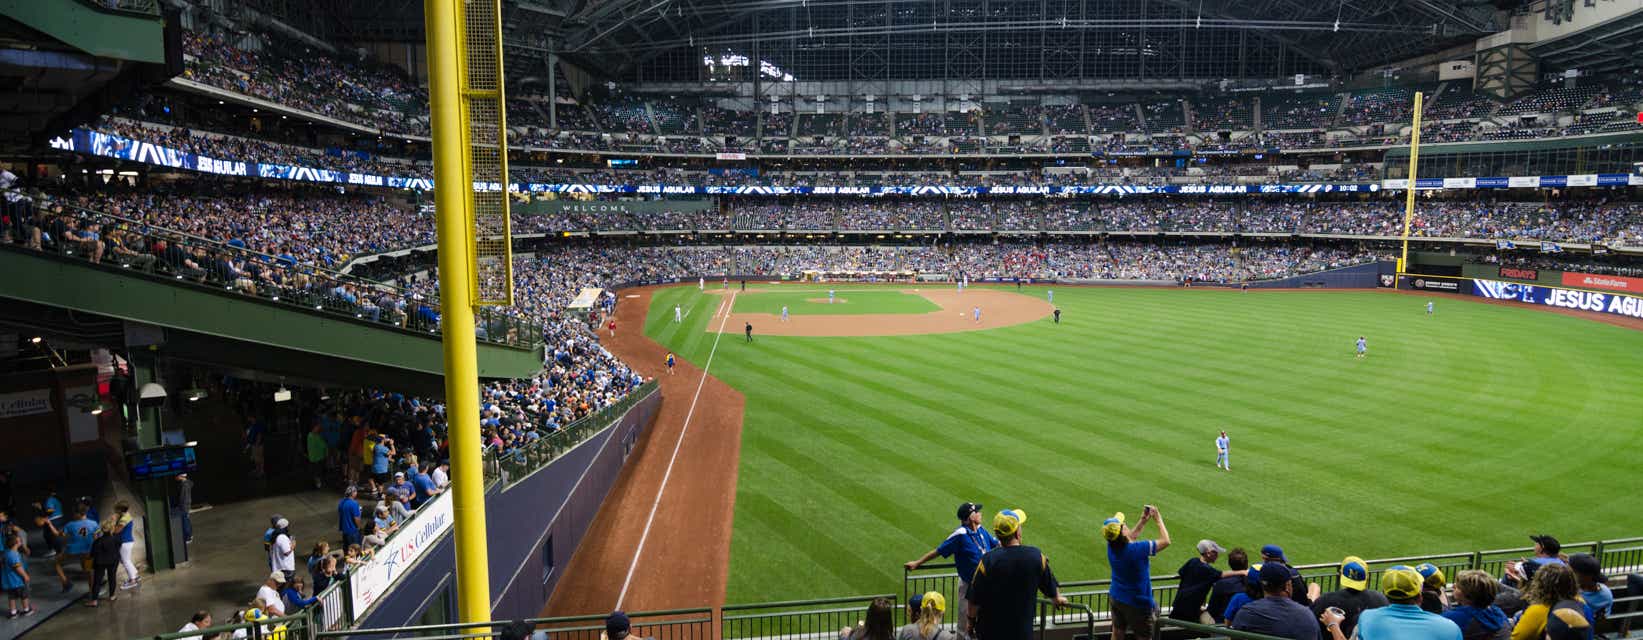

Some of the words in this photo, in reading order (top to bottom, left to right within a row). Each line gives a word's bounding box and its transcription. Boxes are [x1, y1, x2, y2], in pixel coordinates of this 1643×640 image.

[636, 185, 660, 193] JESUS
[663, 185, 695, 193] AGUILAR
[812, 185, 836, 194] JESUS
[838, 185, 870, 194] AGUILAR
[989, 185, 1014, 194] JESUS
[1016, 185, 1050, 194] AGUILAR
[1178, 185, 1206, 193] JESUS
[1208, 185, 1247, 193] AGUILAR
[1500, 267, 1536, 280] FRIDAYS
[1545, 288, 1605, 312] JESUS
